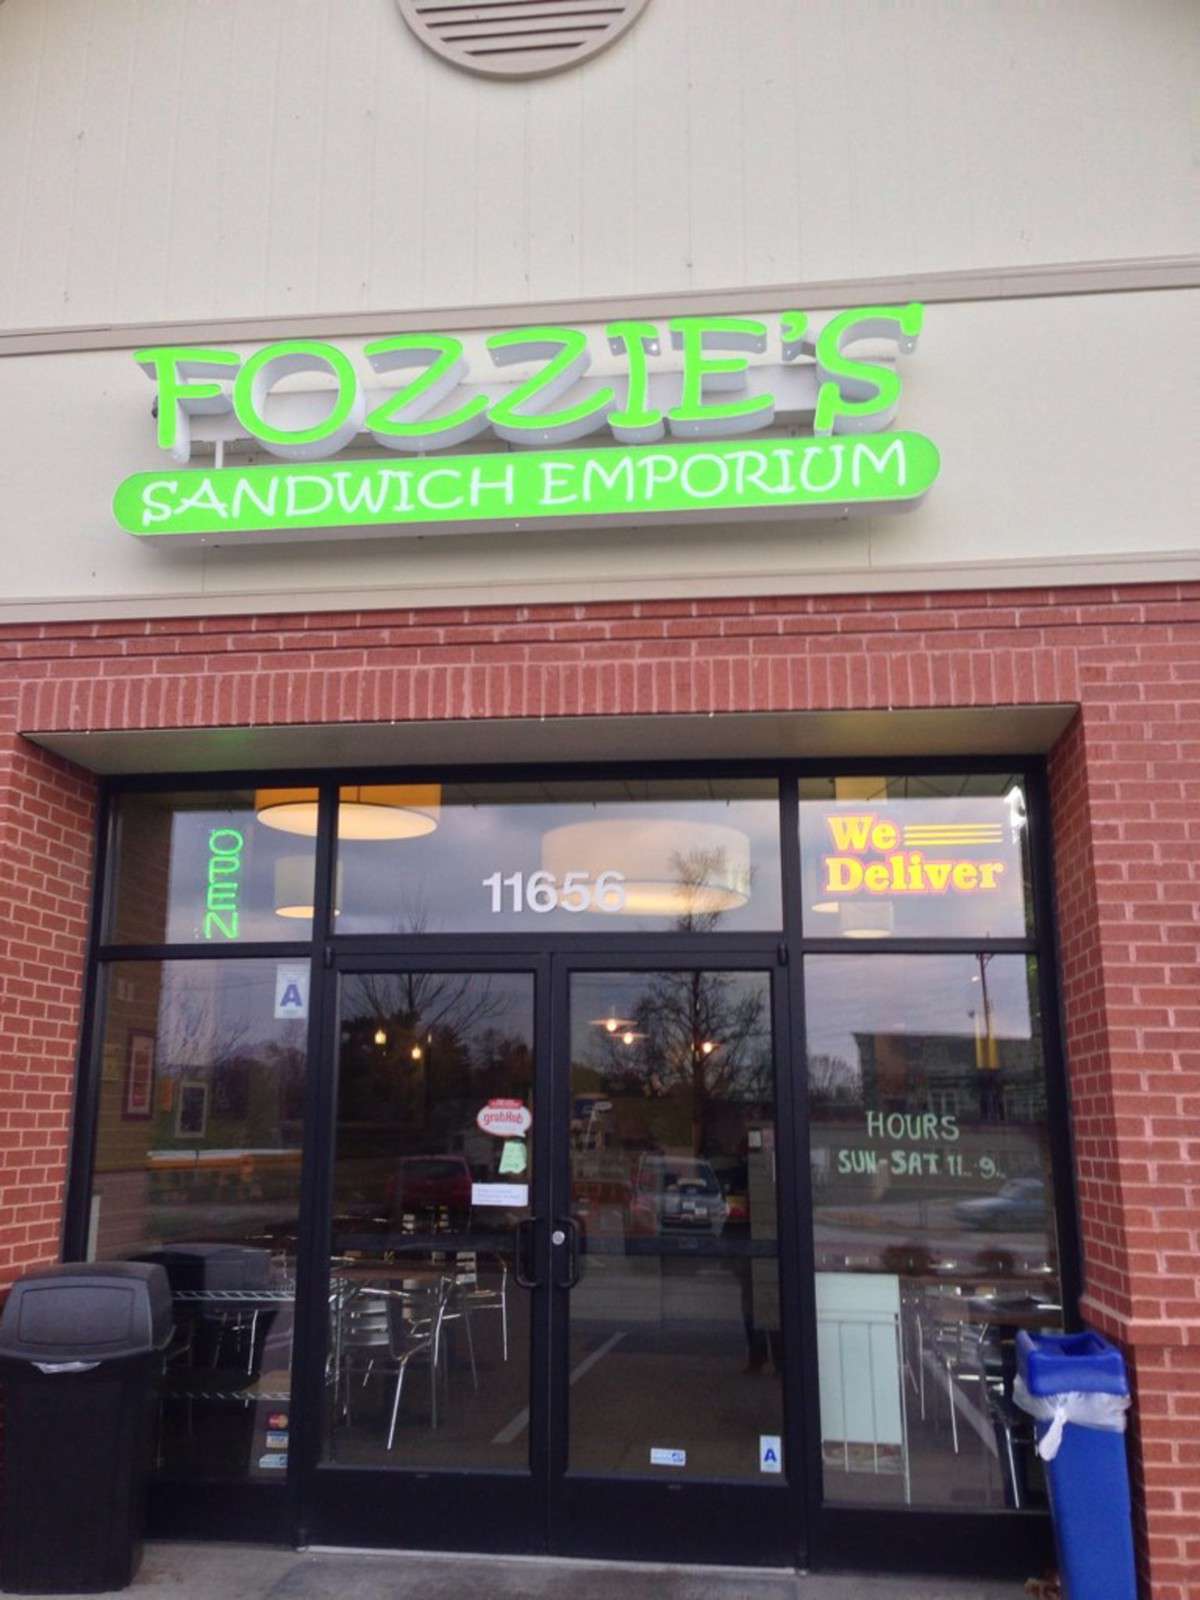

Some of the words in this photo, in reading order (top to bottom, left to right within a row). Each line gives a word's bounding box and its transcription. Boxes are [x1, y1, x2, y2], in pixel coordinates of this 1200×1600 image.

[134, 302, 924, 450] FOZZIE'S
[141, 463, 515, 525] SANDWICH
[539, 438, 908, 507] EMPORIUM
[826, 814, 898, 851] We
[204, 828, 244, 939] OPEN
[482, 870, 626, 912] 11656
[824, 853, 1005, 893] Deliver
[280, 984, 303, 1007] A
[865, 1110, 960, 1141] HOURS
[764, 1448, 777, 1462] A
